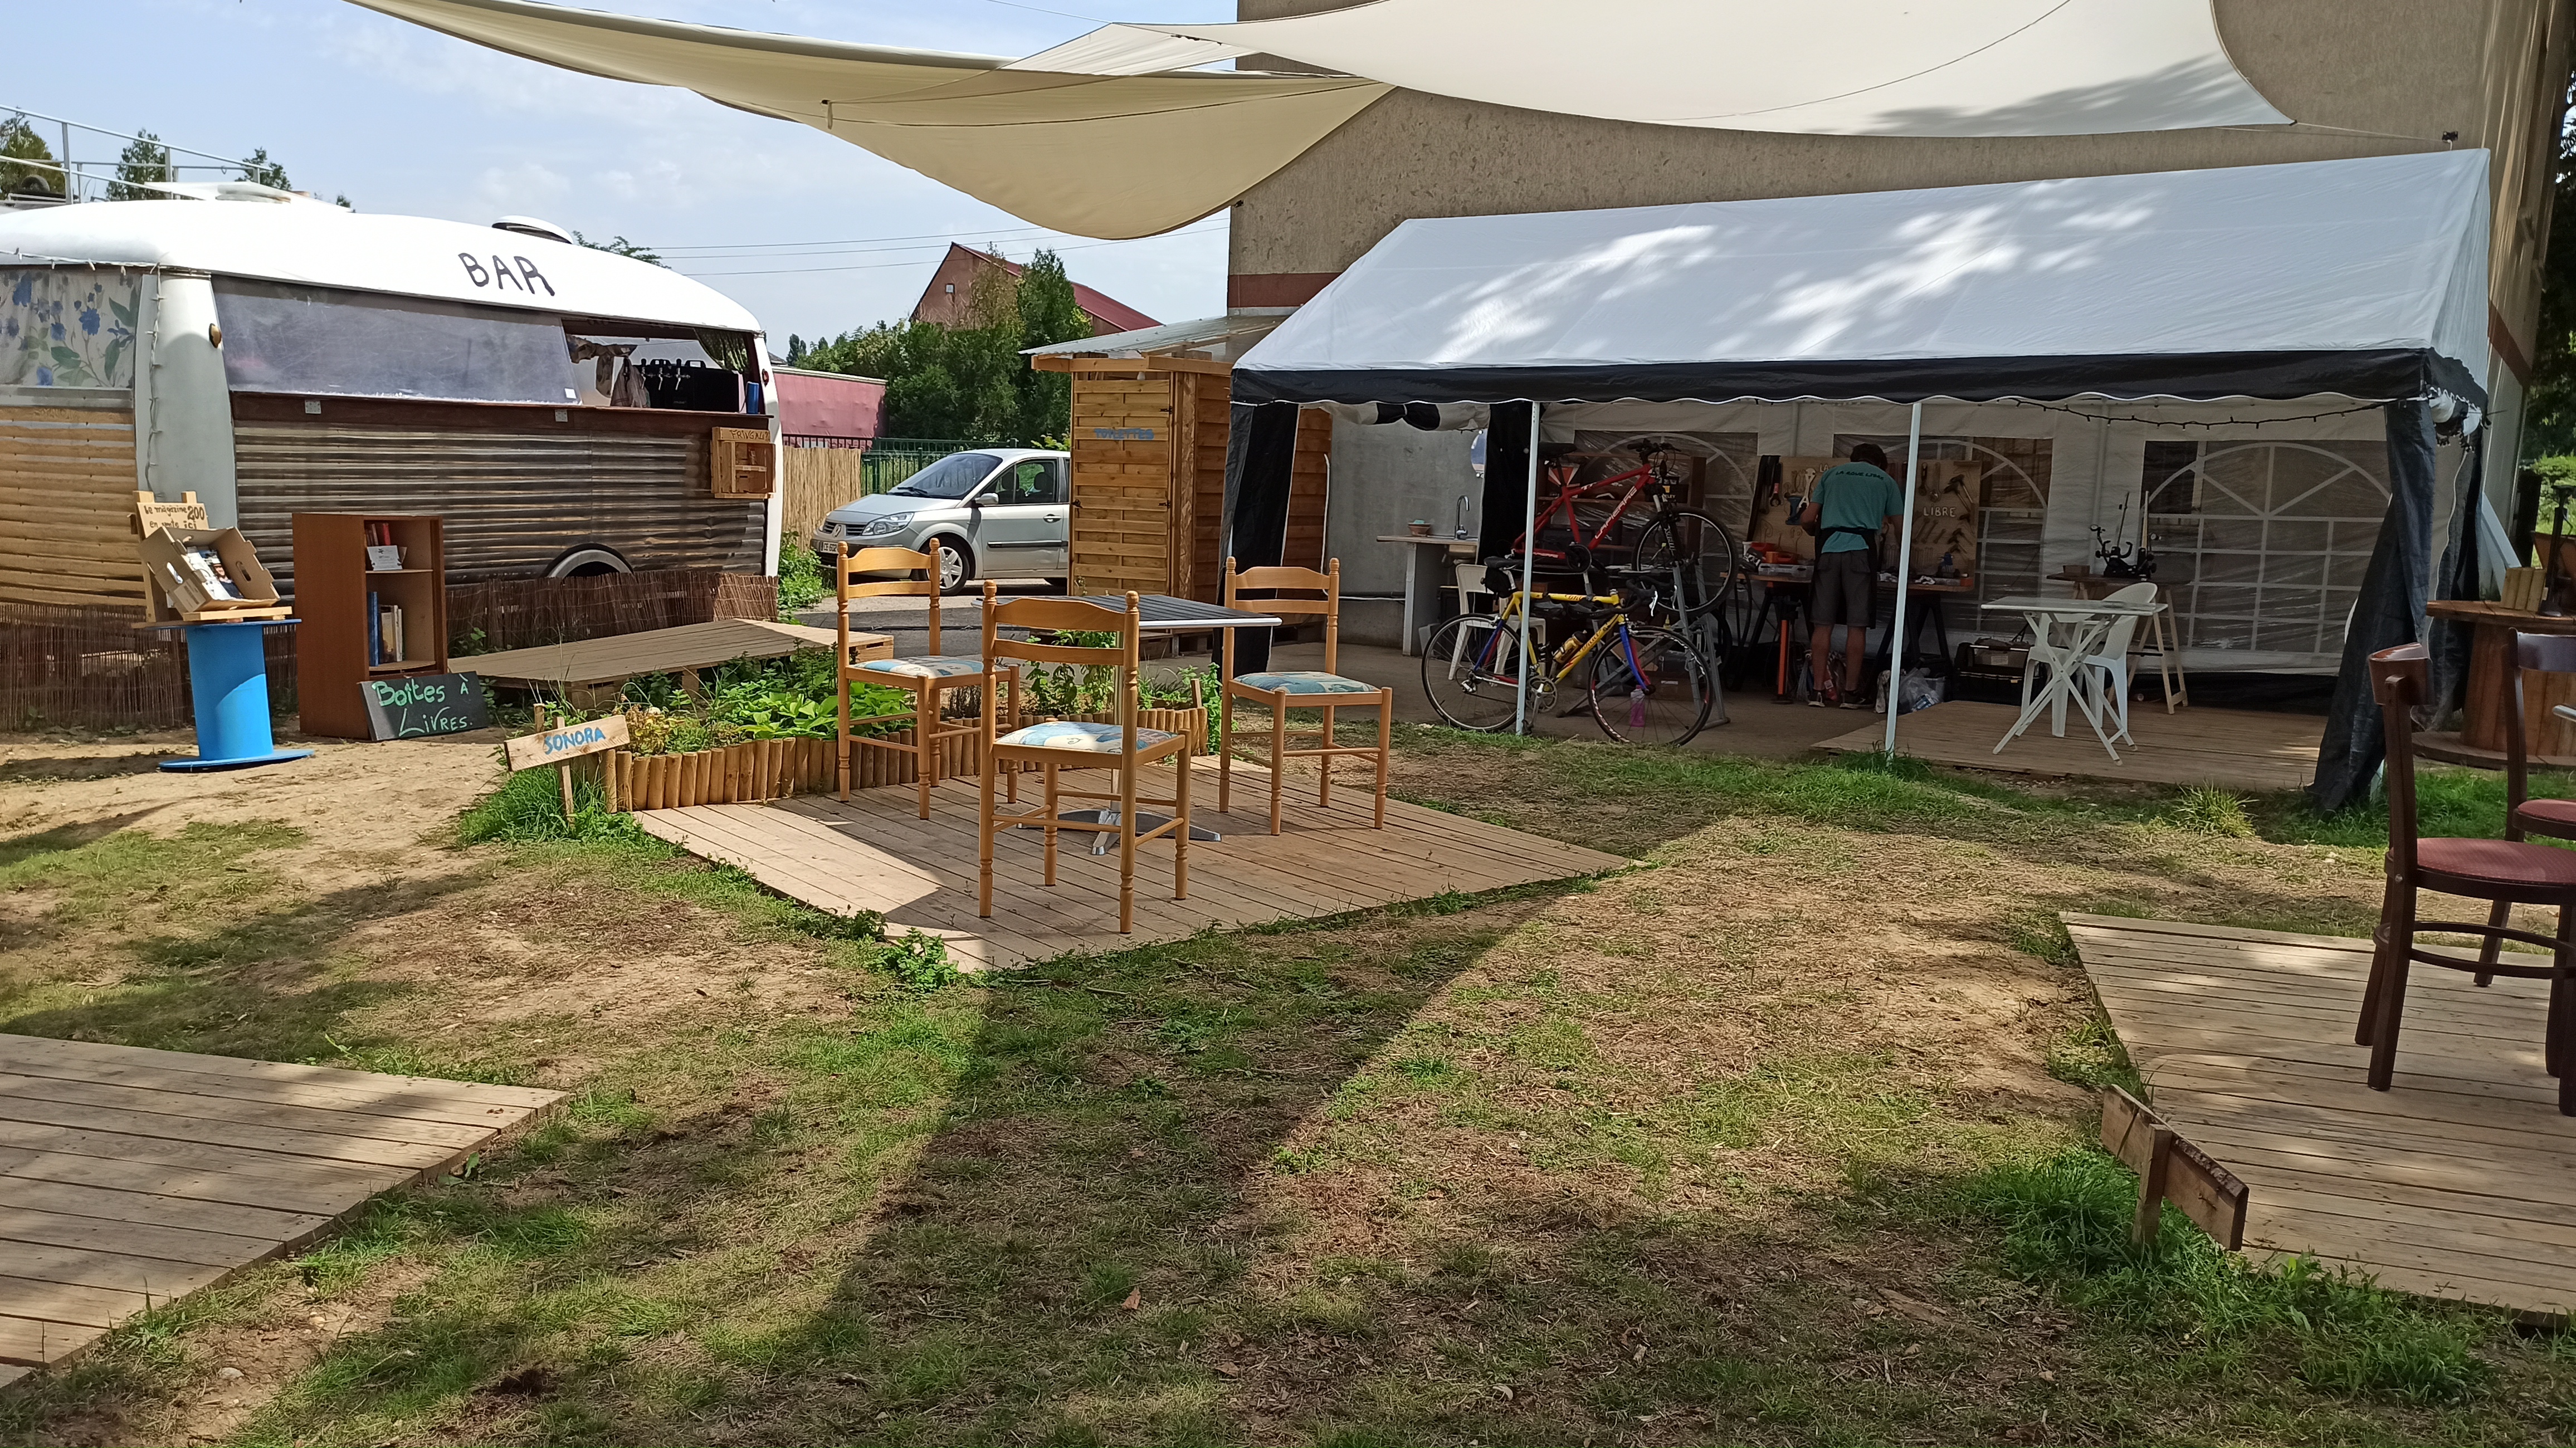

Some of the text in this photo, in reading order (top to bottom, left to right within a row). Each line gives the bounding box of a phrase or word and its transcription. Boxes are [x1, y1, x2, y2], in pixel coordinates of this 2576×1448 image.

[458, 253, 555, 296] BAR
[1094, 428, 1154, 439] TOILETTES
[1819, 464, 1829, 472] LA
[154, 505, 187, 517] magazine
[187, 505, 204, 521] 200
[1923, 507, 1956, 517] LIBRE
[372, 673, 469, 706] Boîtes À
[544, 727, 606, 755] SONORA
